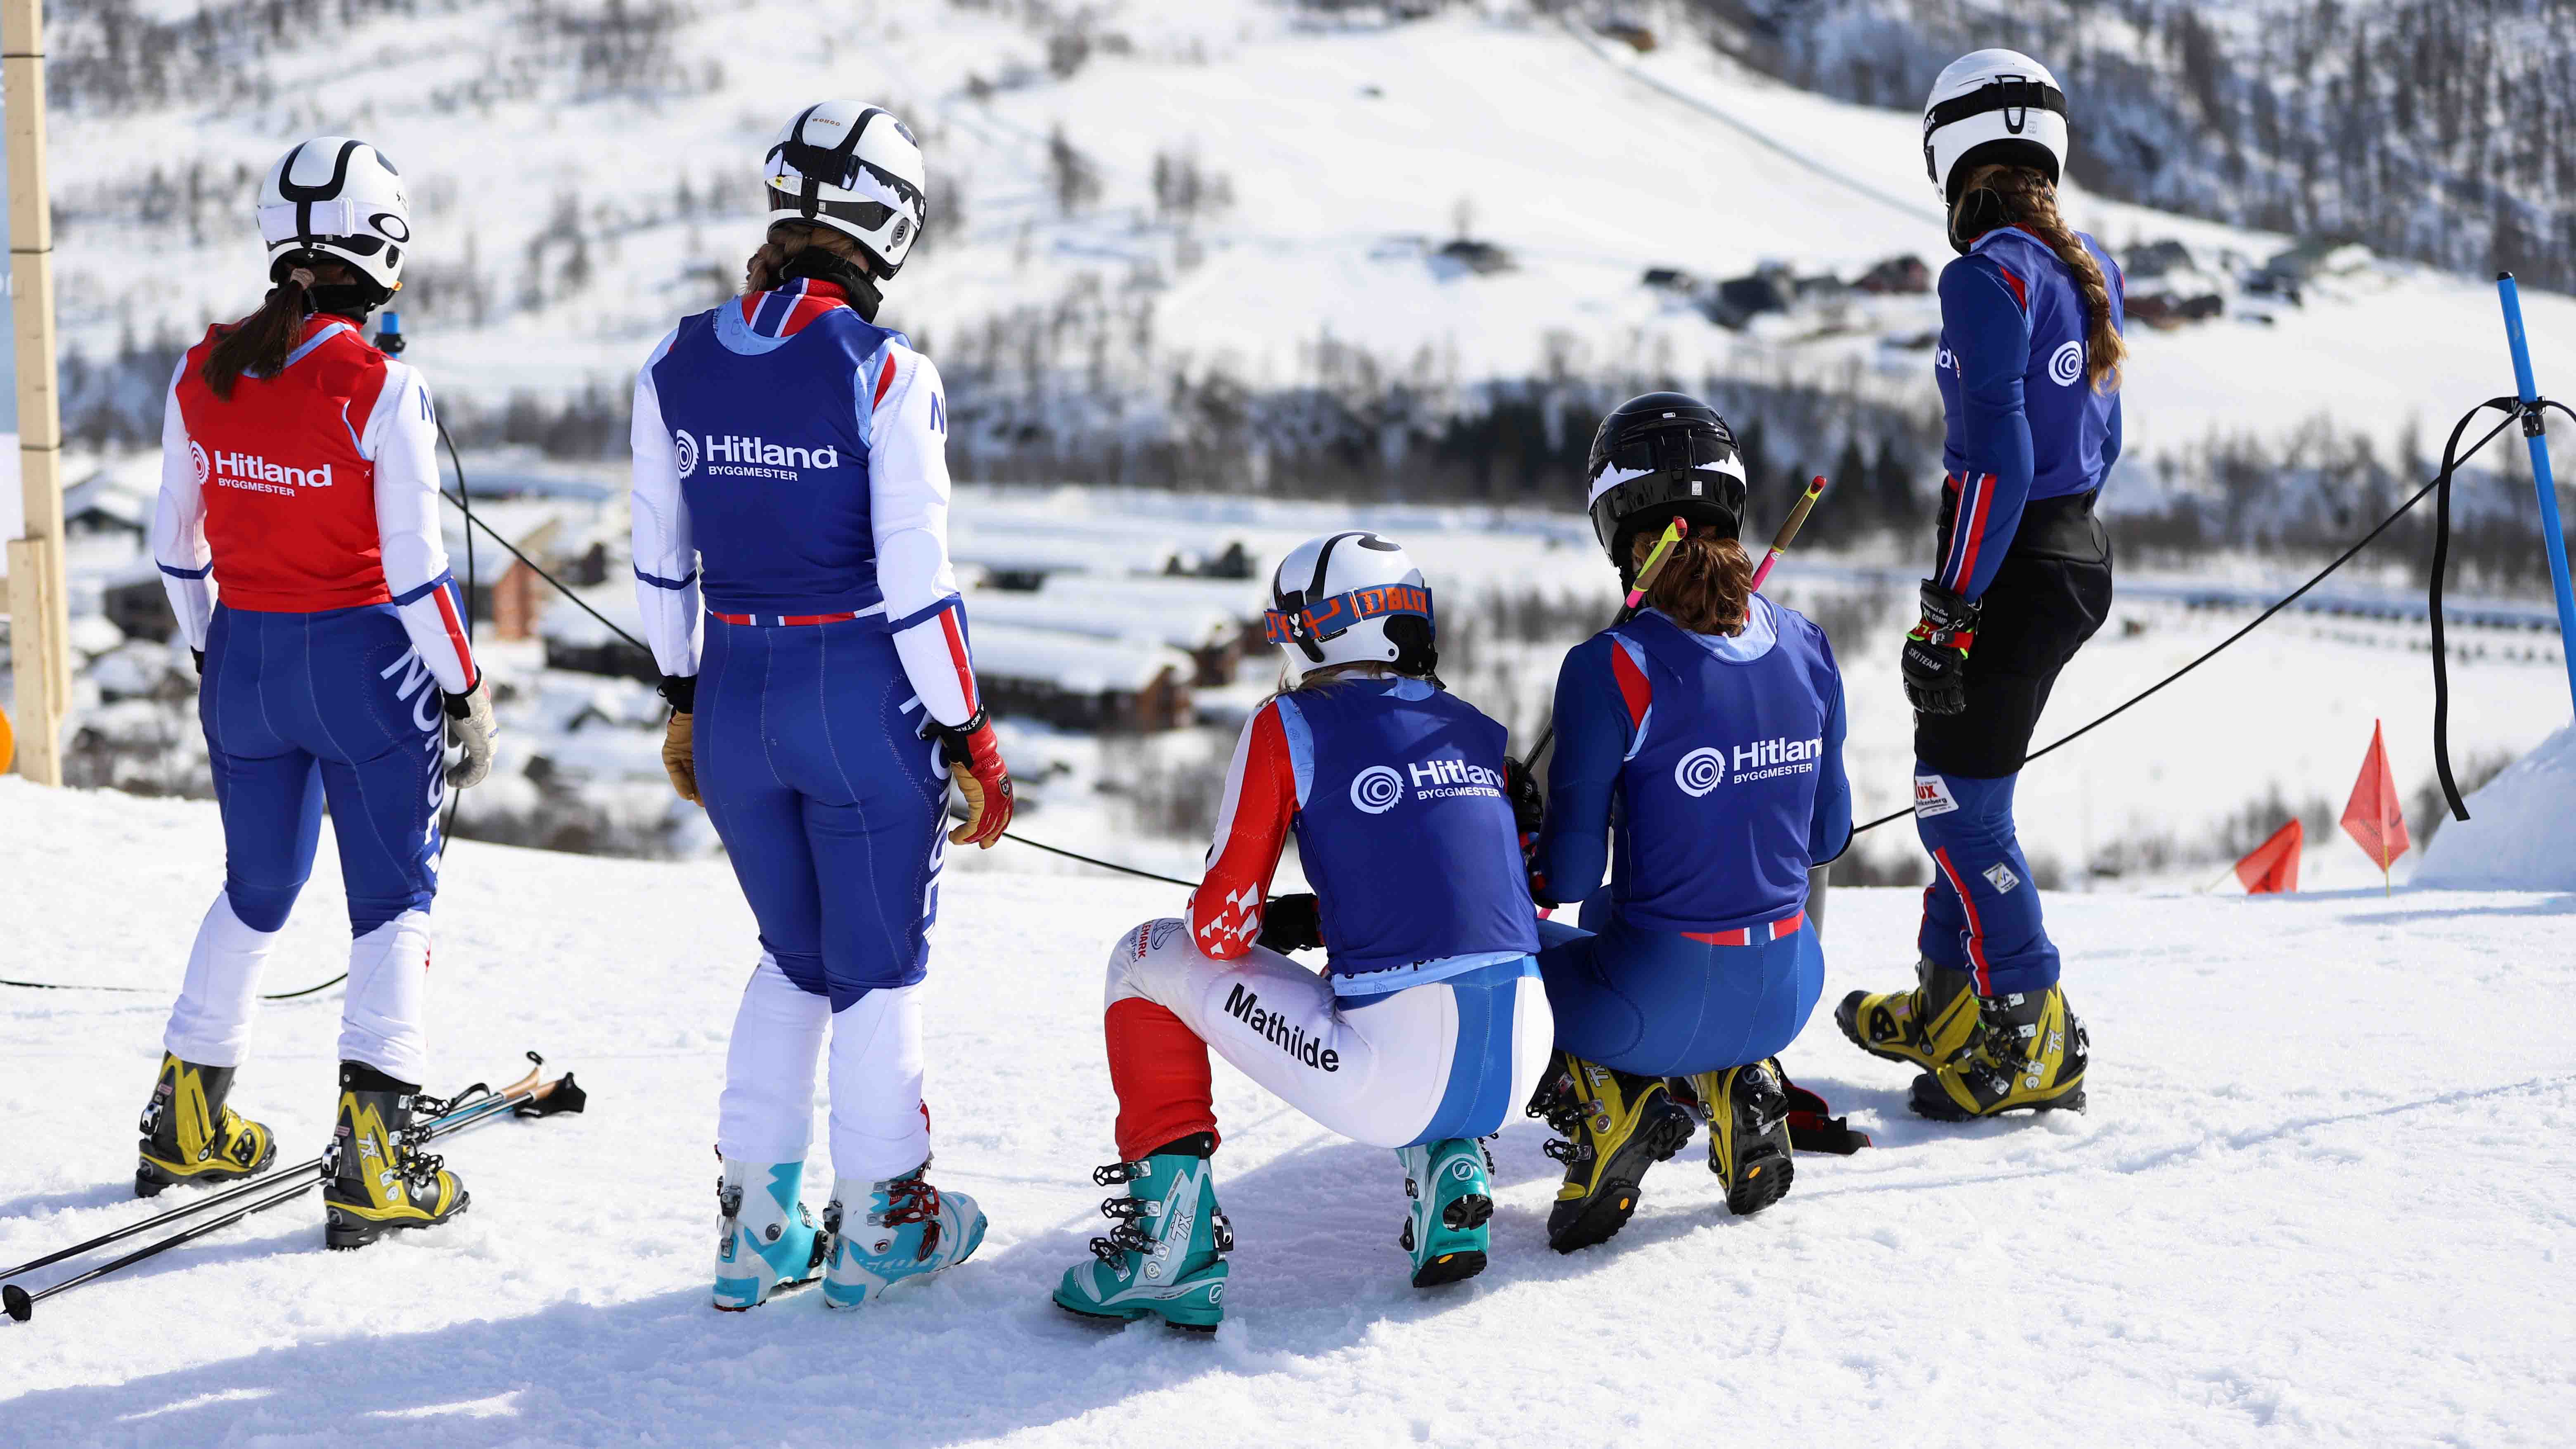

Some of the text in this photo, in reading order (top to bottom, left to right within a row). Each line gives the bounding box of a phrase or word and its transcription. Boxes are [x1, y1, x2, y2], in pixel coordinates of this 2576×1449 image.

[706, 435, 838, 469] Hitland
[214, 450, 332, 488] Hitland
[708, 466, 798, 482] BYGGMESTER
[218, 478, 295, 497] BYGGMESTER
[1908, 648, 1942, 671] SKI TEAM
[954, 713, 981, 732] HESTRA
[1734, 763, 1813, 784] BYGGMESTER
[1418, 786, 1501, 800] BYGGMESTER
[1138, 922, 1152, 959] EMARK
[1224, 983, 1339, 1072] Mathilde
[1170, 1208, 1193, 1241] TX
